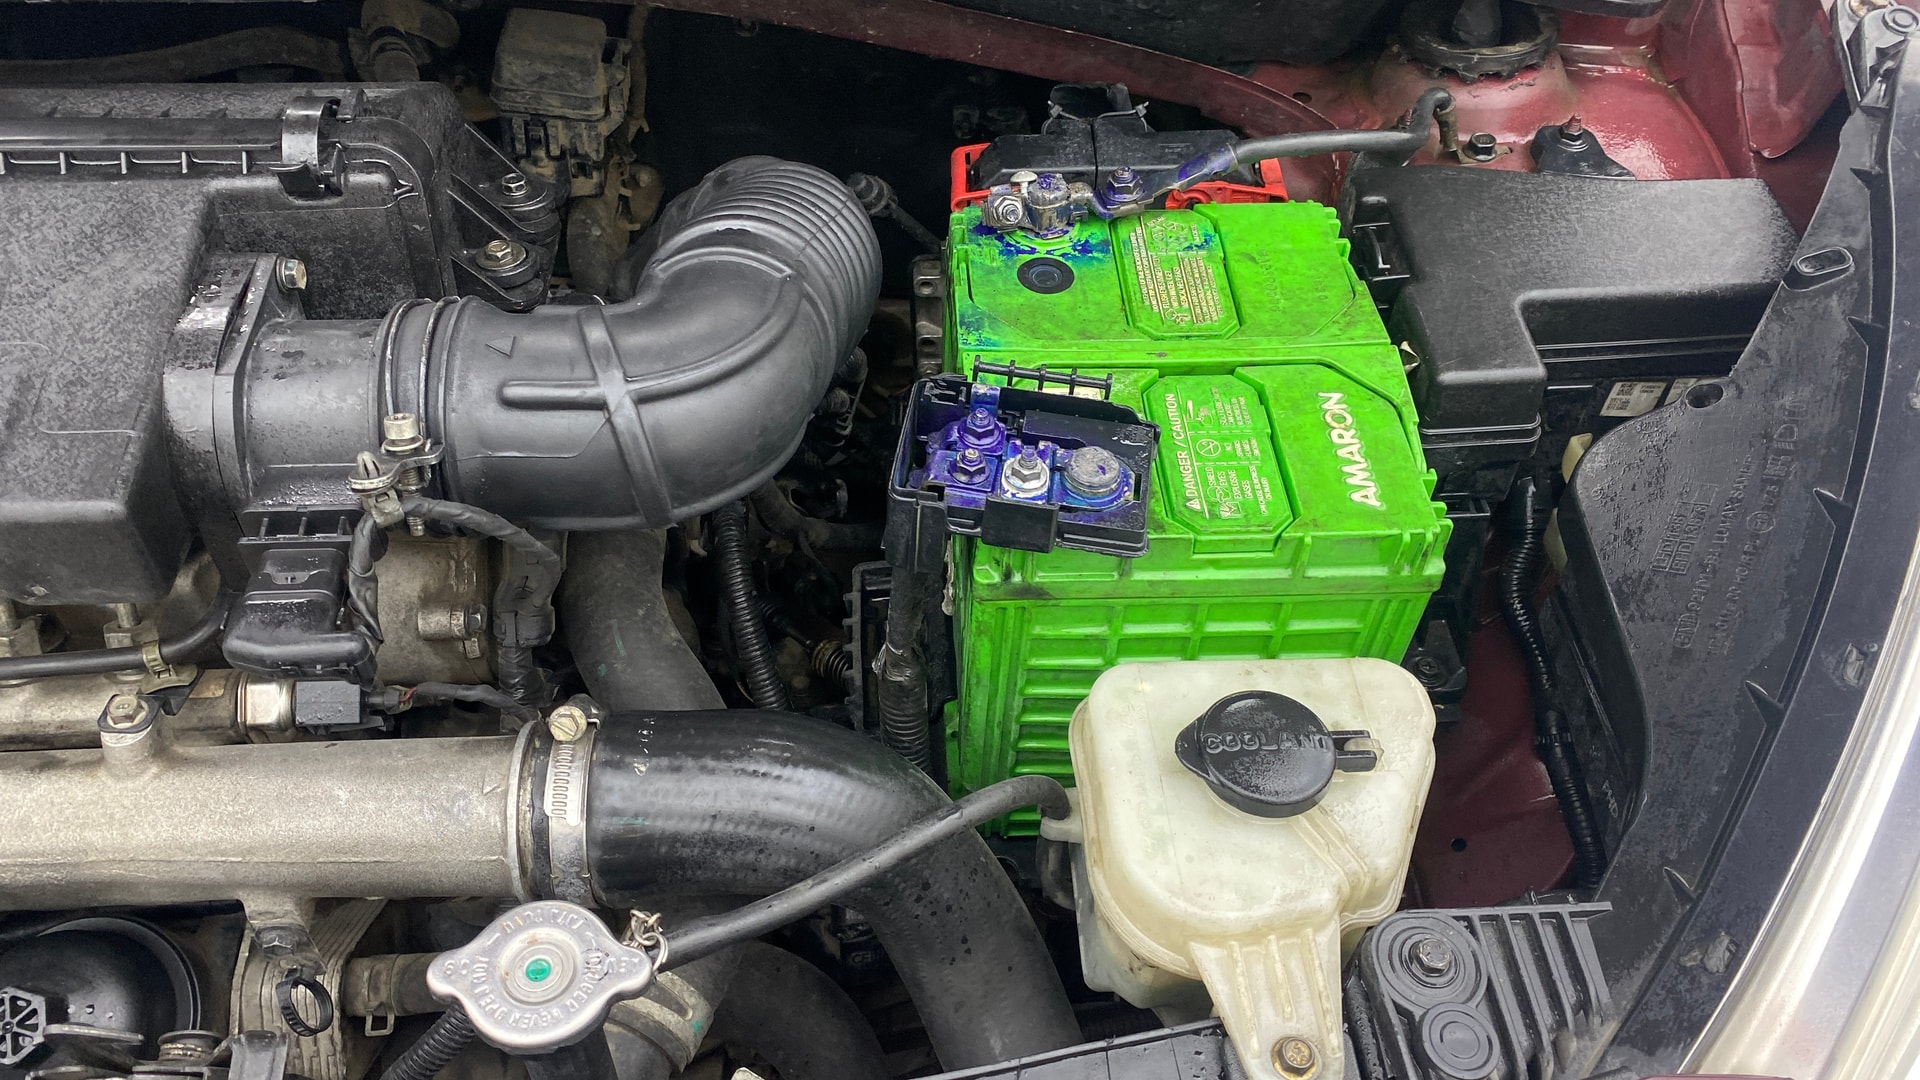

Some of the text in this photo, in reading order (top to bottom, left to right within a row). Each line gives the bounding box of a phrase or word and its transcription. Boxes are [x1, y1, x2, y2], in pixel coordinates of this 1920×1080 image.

[1318, 391, 1382, 507] AMARON
[1178, 451, 1197, 496] DANGER
[1206, 466, 1216, 485] SHIELD
[1218, 471, 1228, 485] EYES
[1242, 480, 1253, 498] GASES
[1202, 731, 1328, 754] COOLANT
